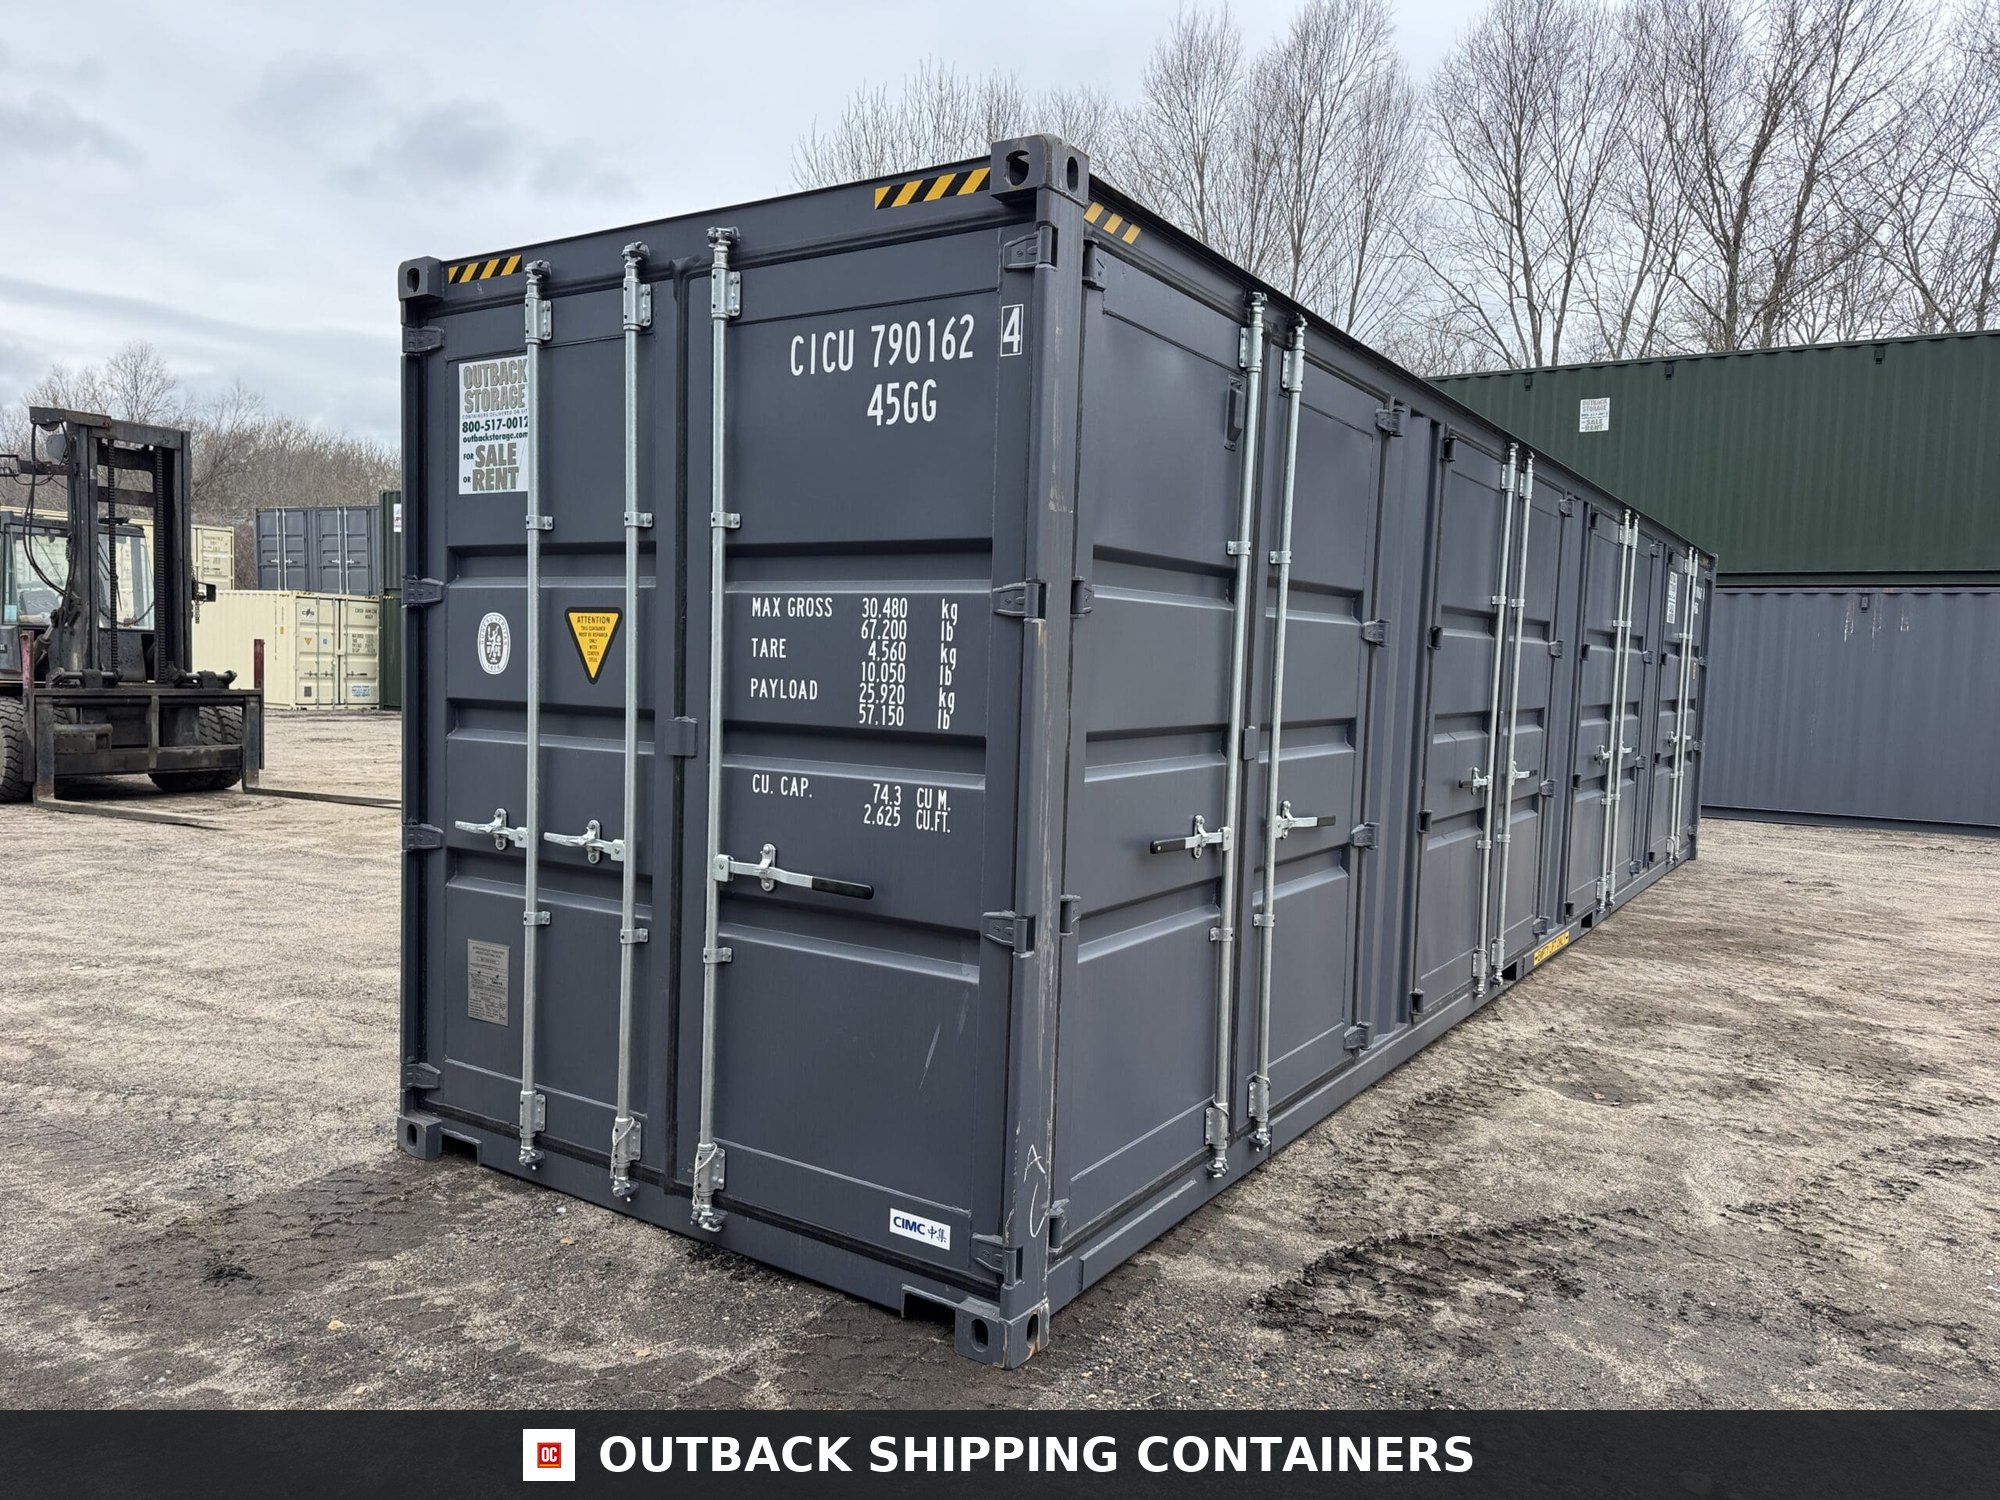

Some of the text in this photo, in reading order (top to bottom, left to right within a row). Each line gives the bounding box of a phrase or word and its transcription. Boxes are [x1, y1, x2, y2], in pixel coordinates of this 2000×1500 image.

[790, 307, 1021, 376] CICU 790162 4
[463, 358, 528, 390] OUTBACK
[464, 384, 526, 414] STORAGE
[867, 378, 937, 426] 45GG
[462, 415, 528, 433] 800-517-0012
[475, 443, 517, 468] SALE
[473, 466, 519, 491] RENT
[577, 616, 611, 624] ATTENTION
[751, 597, 781, 617] MAX
[787, 597, 833, 618] GROSS
[941, 598, 958, 626] kg
[941, 620, 953, 641] lb
[751, 638, 787, 658] TARE
[940, 642, 957, 671] kg
[939, 665, 952, 686] lb
[750, 678, 818, 700] PAYLOAD
[938, 686, 955, 715] kg
[937, 709, 950, 730] lb
[752, 774, 773, 794] CU.
[780, 776, 812, 798] CAP.
[873, 783, 902, 806] 74.3
[893, 1215, 926, 1236] CIMC
